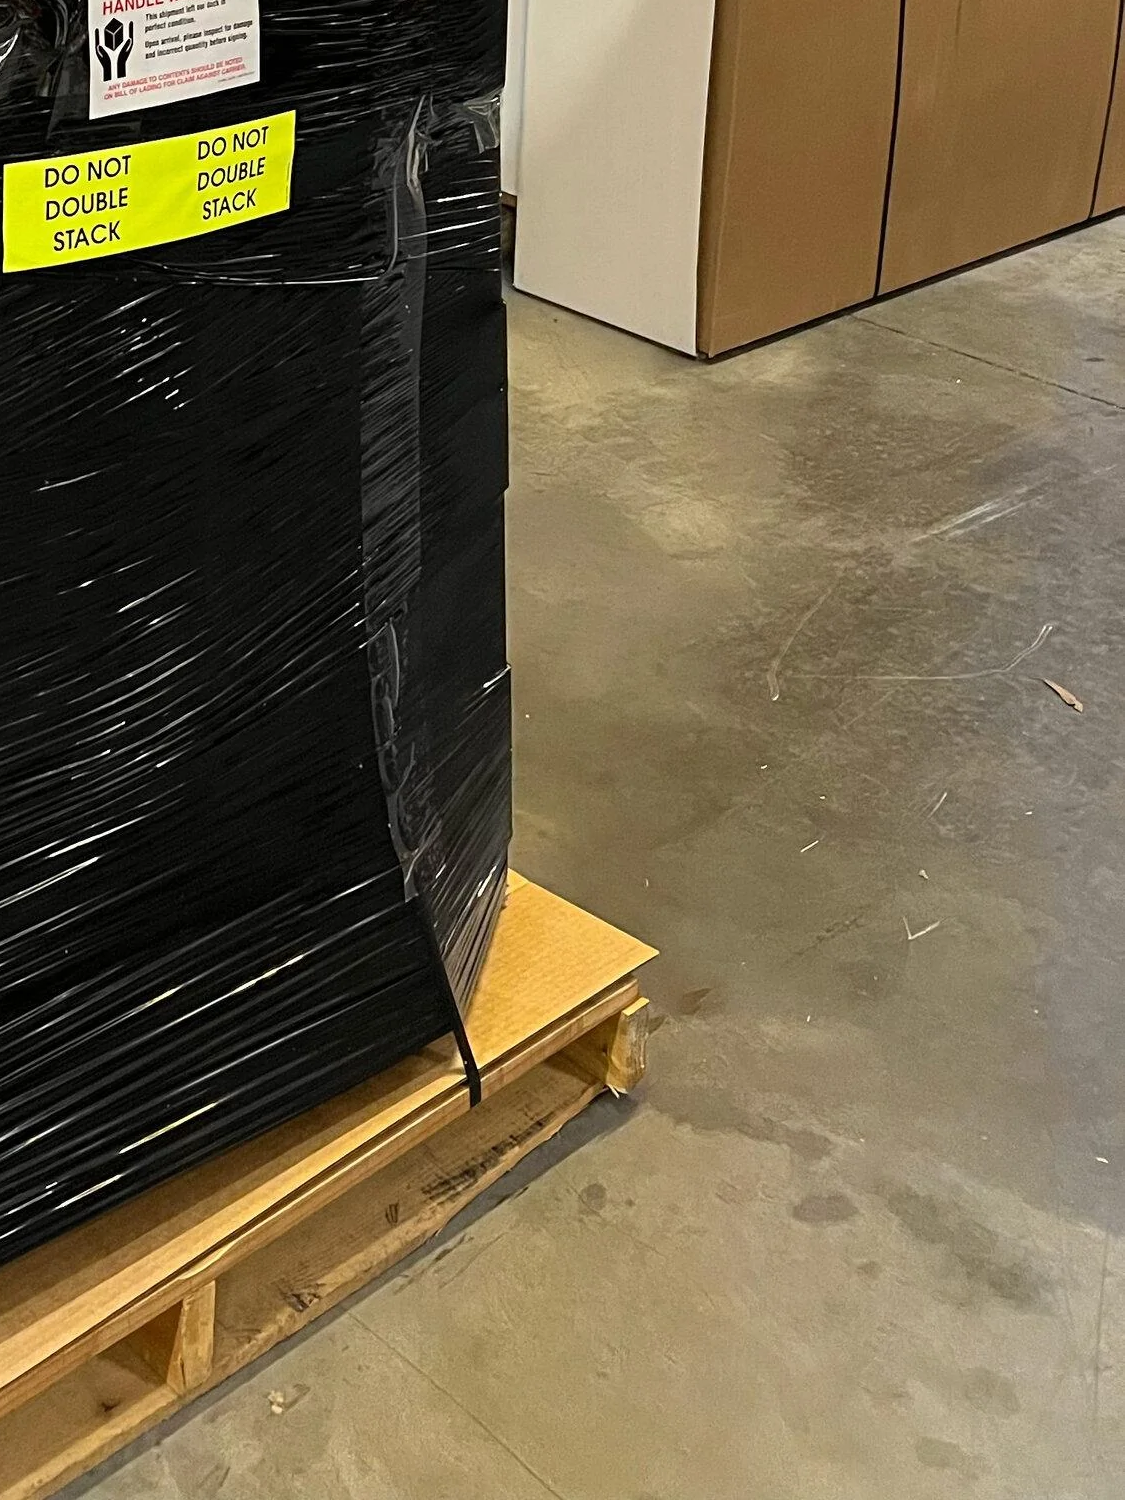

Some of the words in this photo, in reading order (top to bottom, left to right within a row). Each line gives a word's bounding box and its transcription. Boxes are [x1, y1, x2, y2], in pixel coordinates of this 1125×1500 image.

[108, 83, 120, 91] ANY
[122, 78, 147, 88] DAMAGE
[191, 63, 214, 74] SHOULD
[164, 80, 176, 88] FOR
[197, 137, 226, 160] DO
[232, 126, 269, 152] NOT
[44, 164, 80, 188] DO
[87, 155, 131, 180] NOT
[197, 157, 266, 191] DOUBLE
[45, 187, 128, 221] DOUBLE
[202, 188, 257, 220] STACK
[53, 221, 121, 252] STACK
